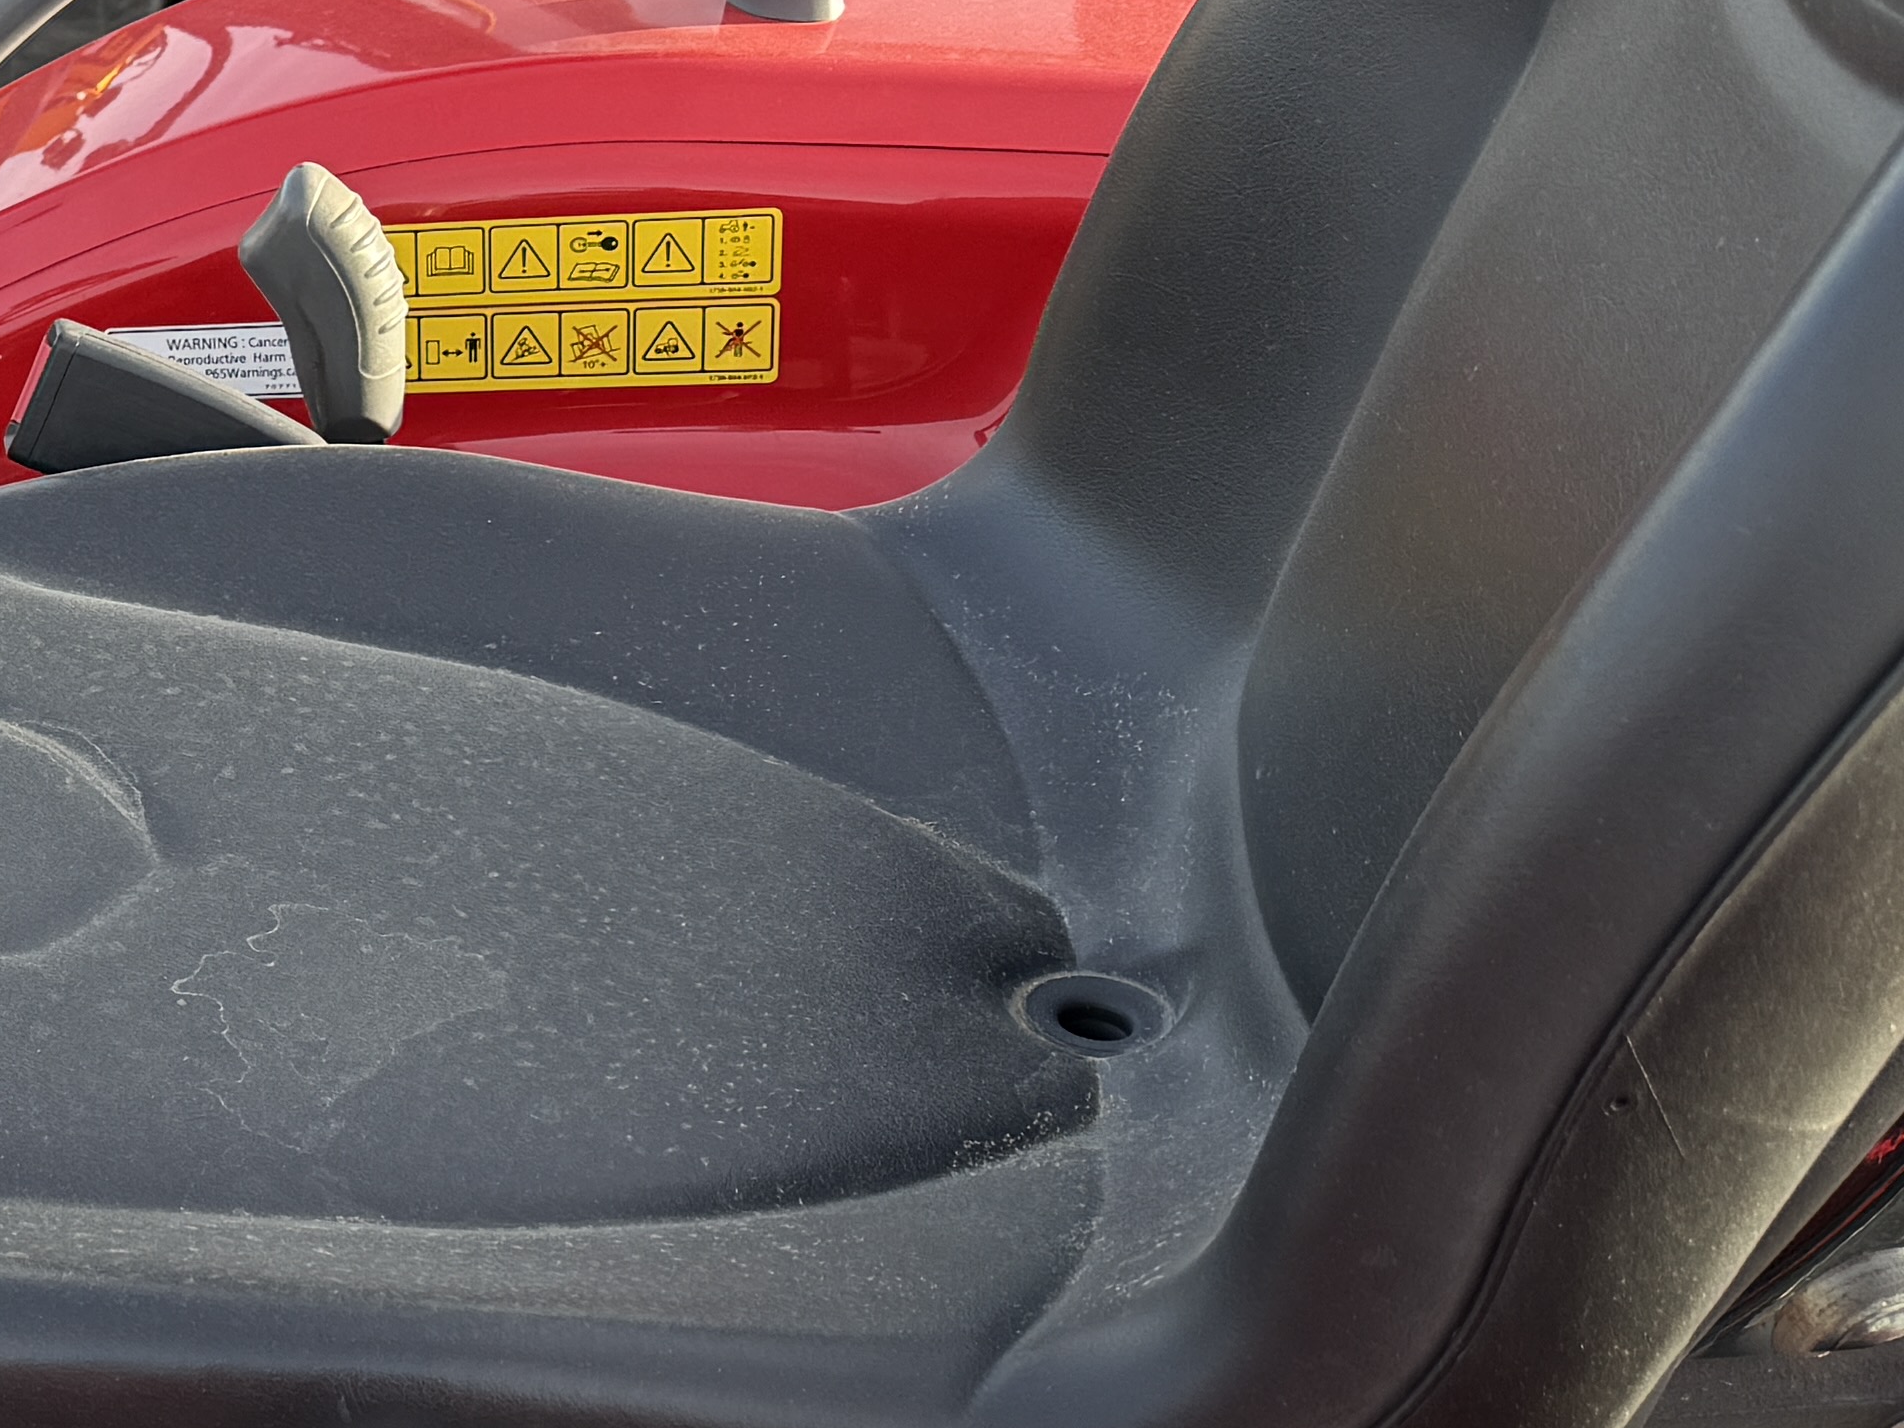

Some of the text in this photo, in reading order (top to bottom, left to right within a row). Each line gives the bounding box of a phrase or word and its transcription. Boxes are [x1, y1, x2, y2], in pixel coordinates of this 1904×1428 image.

[166, 335, 238, 351] WARNING
[248, 336, 289, 348] Cancer
[253, 352, 286, 363] Harm
